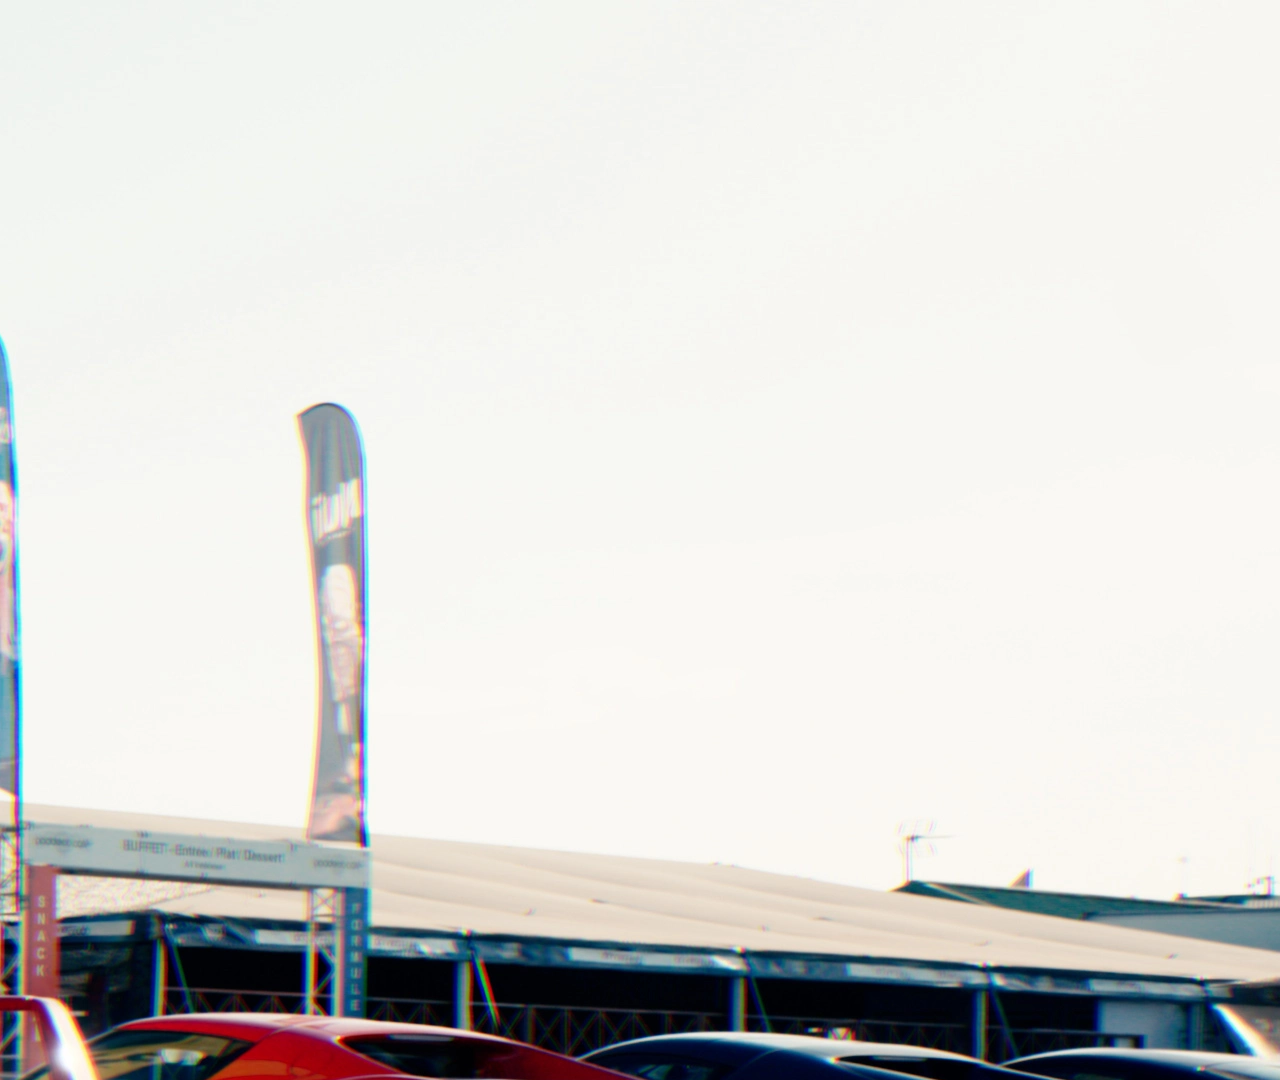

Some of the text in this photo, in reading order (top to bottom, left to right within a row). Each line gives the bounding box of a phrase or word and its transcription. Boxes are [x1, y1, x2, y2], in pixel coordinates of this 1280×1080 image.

[122, 839, 166, 855] BUFFET
[174, 843, 208, 858] Entrée
[216, 847, 236, 860] Plat
[243, 849, 283, 863] Dessert
[34, 894, 47, 978] SNACK
[349, 902, 361, 1011] FORMULE
